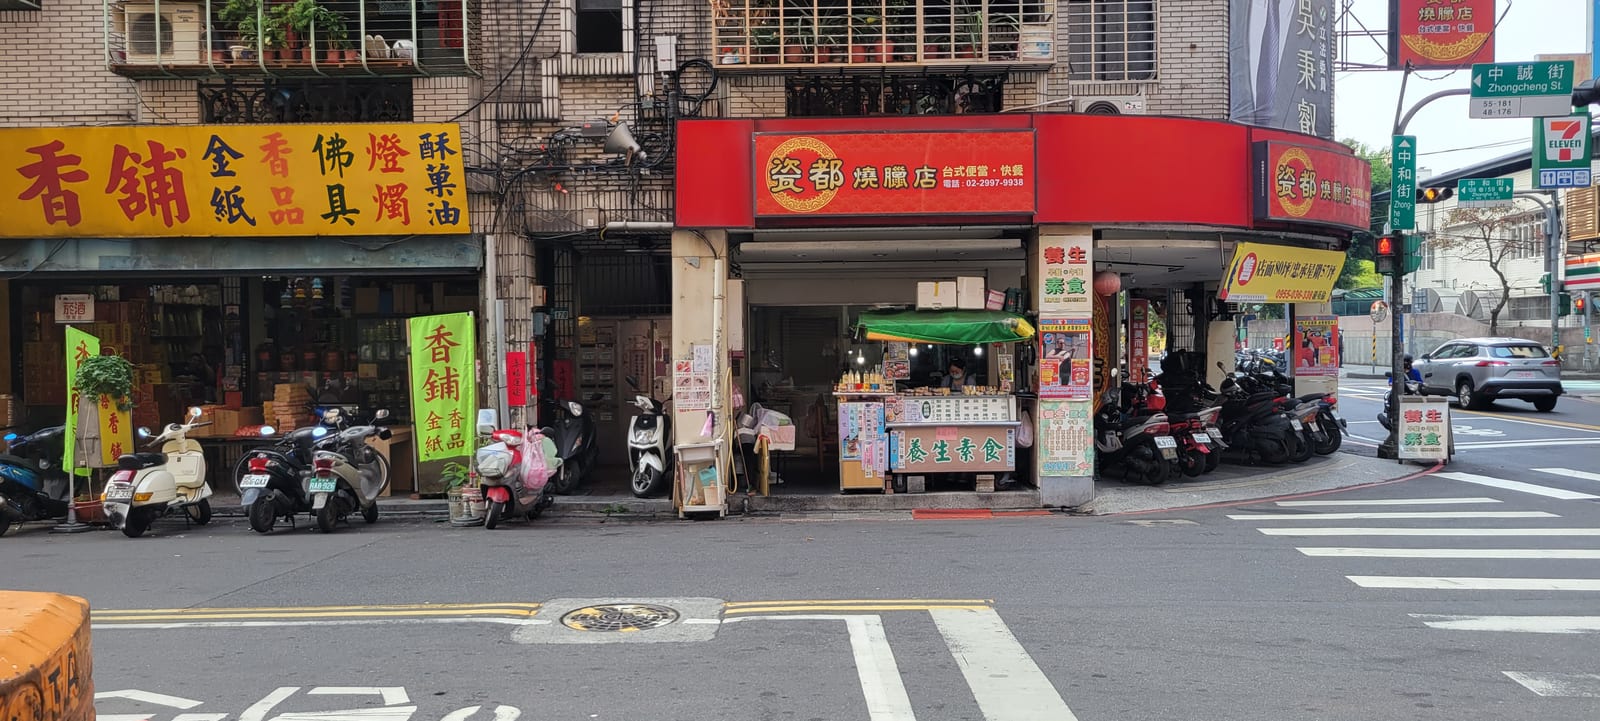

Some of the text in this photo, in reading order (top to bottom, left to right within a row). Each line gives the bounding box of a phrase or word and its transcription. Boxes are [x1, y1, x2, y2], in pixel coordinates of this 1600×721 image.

[1418, 6, 1473, 21] 燒臘店
[1319, 26, 1327, 93] 立法委員
[1488, 64, 1565, 81] 中誠街
[1488, 81, 1563, 93] Zhongcheng St.
[1551, 120, 1581, 160] 7
[16, 140, 191, 228] 香舖
[202, 134, 256, 227] 金紙
[259, 132, 304, 225] 香品
[312, 132, 360, 226] 佛具
[365, 132, 411, 226] 燈燭
[417, 131, 461, 226] 酥菓油
[770, 157, 939, 194] 瓷都 燒臘店
[966, 178, 1024, 187] 02-2997-9938
[1277, 164, 1317, 200] 瓷都
[1320, 179, 1351, 205] 燒臘店
[1397, 149, 1411, 198] 中和街
[1468, 180, 1504, 188] 中和街
[1394, 201, 1413, 210] Zhong-
[1044, 246, 1087, 264] 養生
[1239, 256, 1255, 281] 售
[1045, 277, 1087, 295] 素食
[422, 324, 461, 403] 香鋪
[423, 411, 444, 452] 金紙
[446, 408, 465, 450] 香品
[1404, 409, 1443, 423] 養生
[906, 437, 1004, 463] 養生素食
[1404, 432, 1442, 446] 素食
